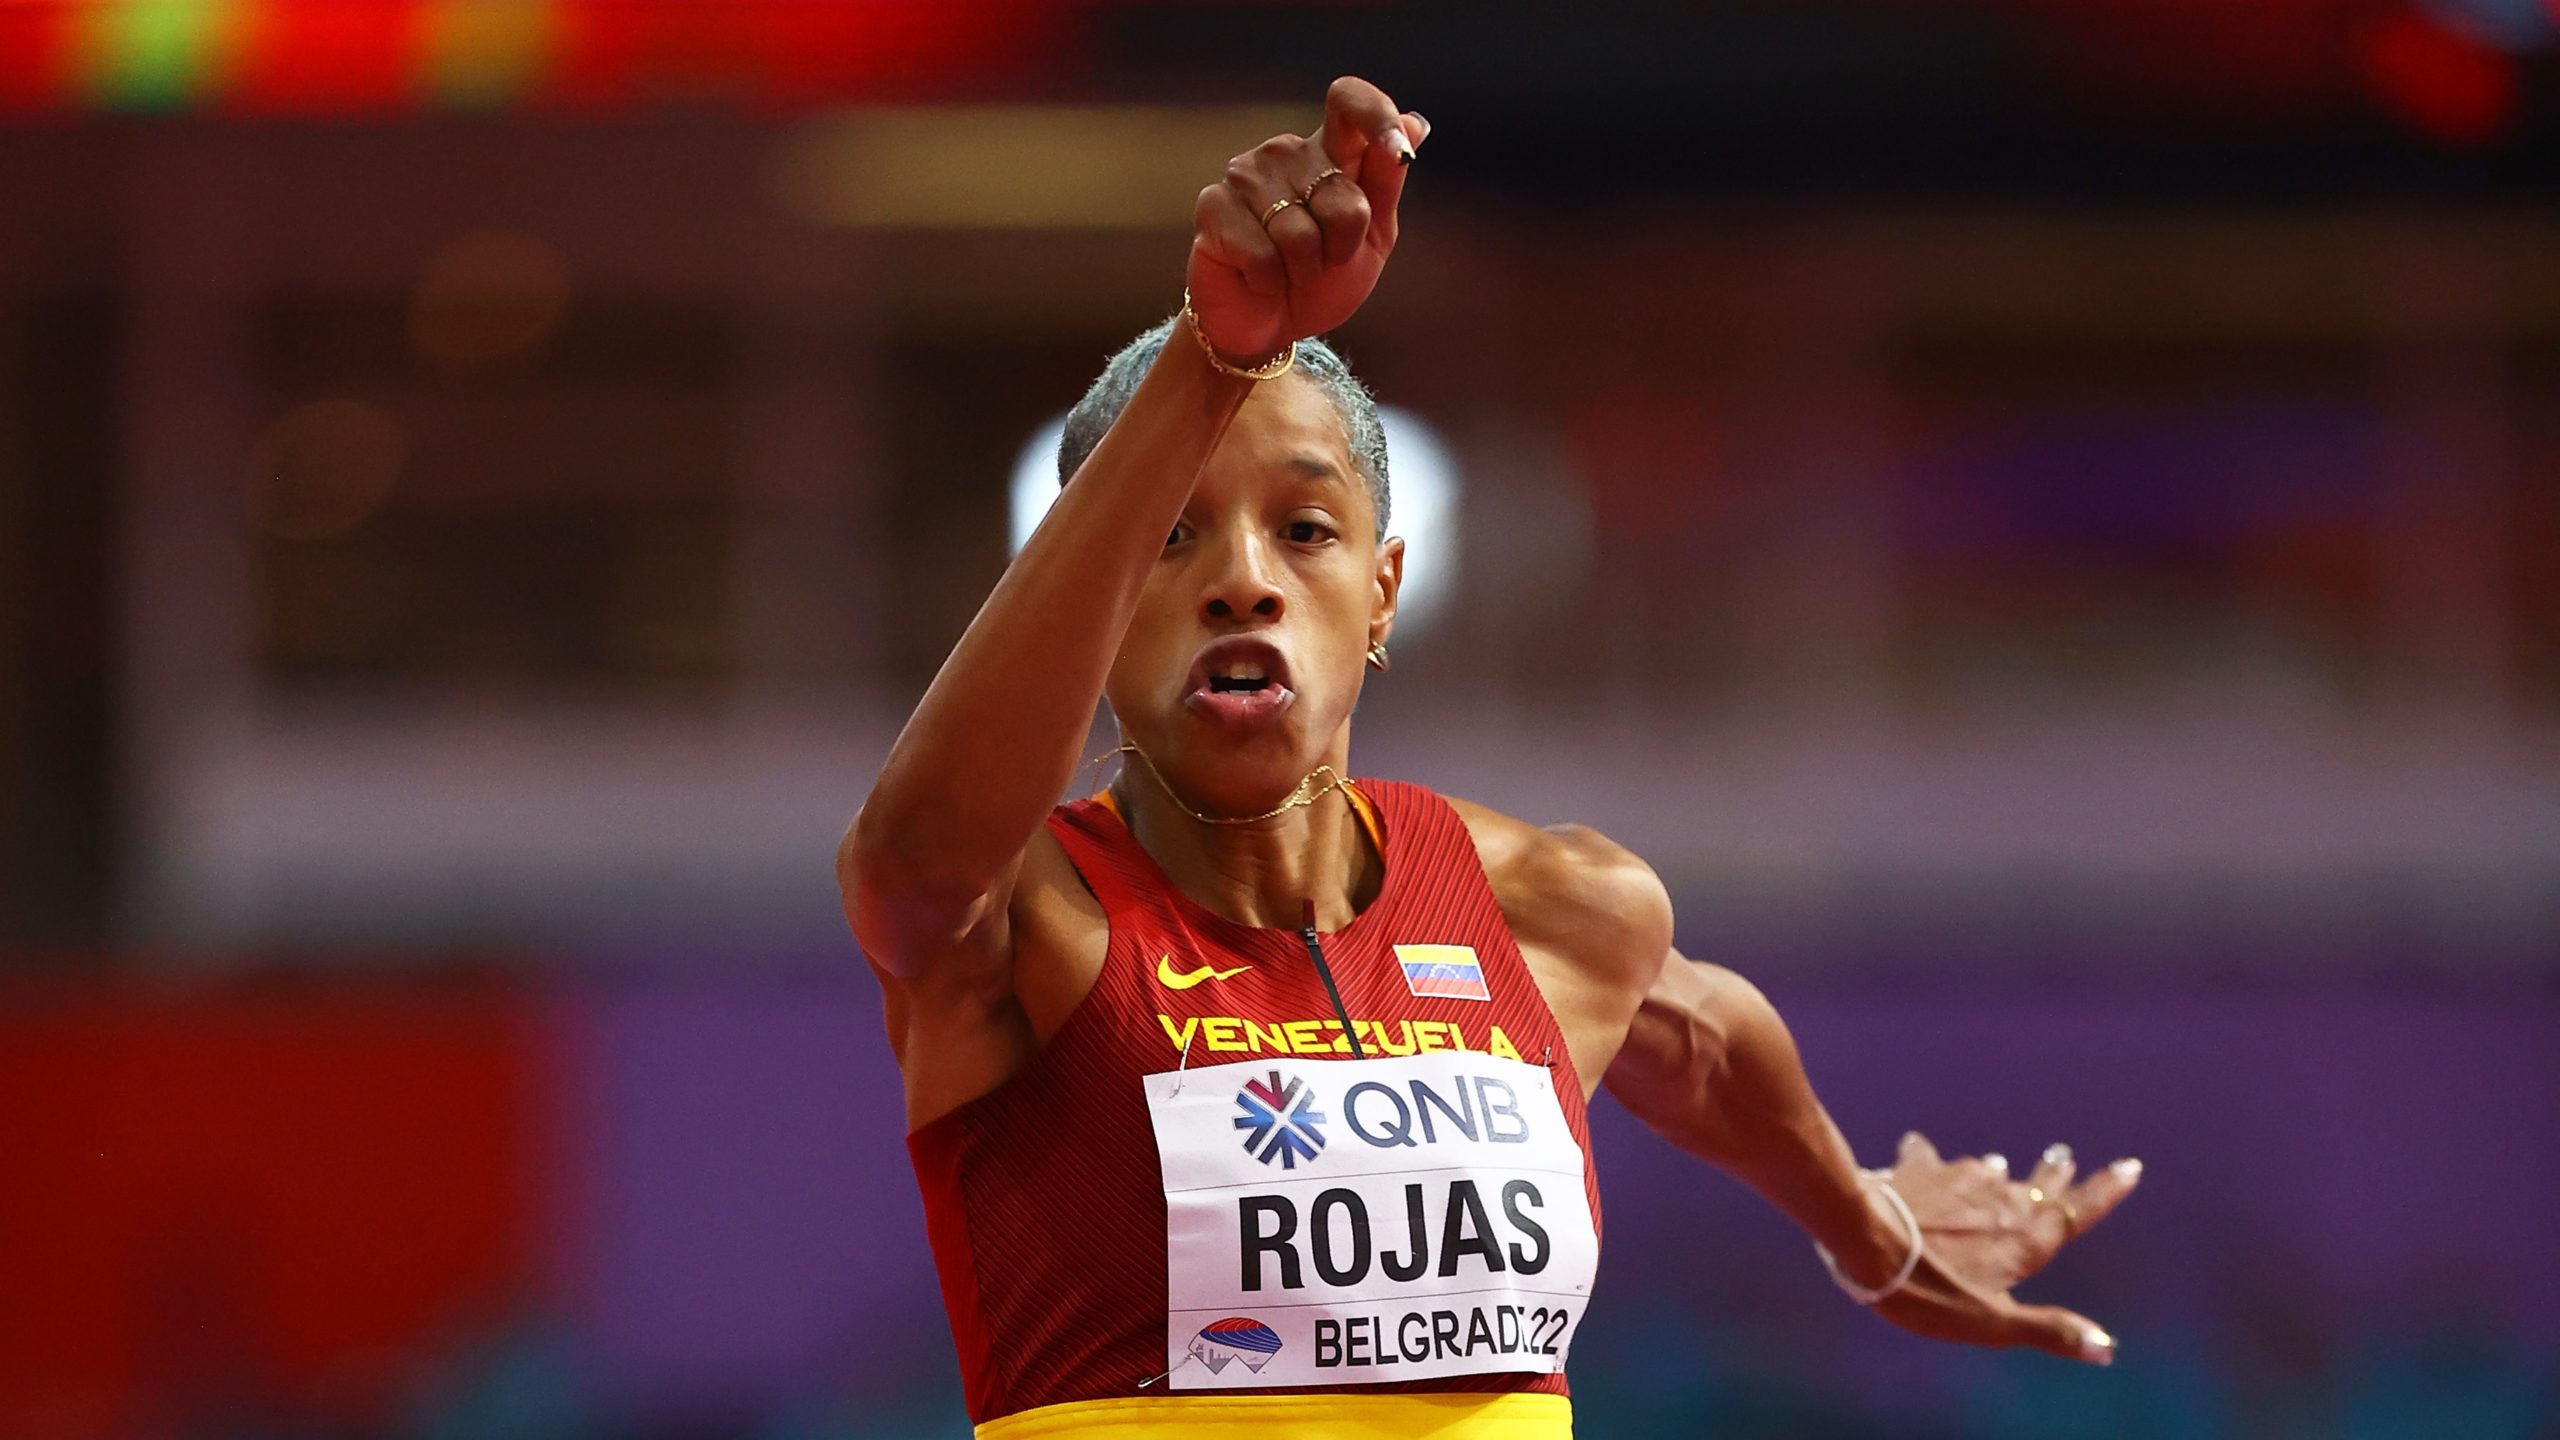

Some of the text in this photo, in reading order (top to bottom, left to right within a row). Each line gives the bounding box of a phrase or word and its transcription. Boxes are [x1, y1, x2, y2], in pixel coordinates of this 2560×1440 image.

[1157, 1013, 1524, 1063] VENEZUELA
[1343, 1075, 1529, 1148] QNB
[1238, 1179, 1551, 1292] ROJAS
